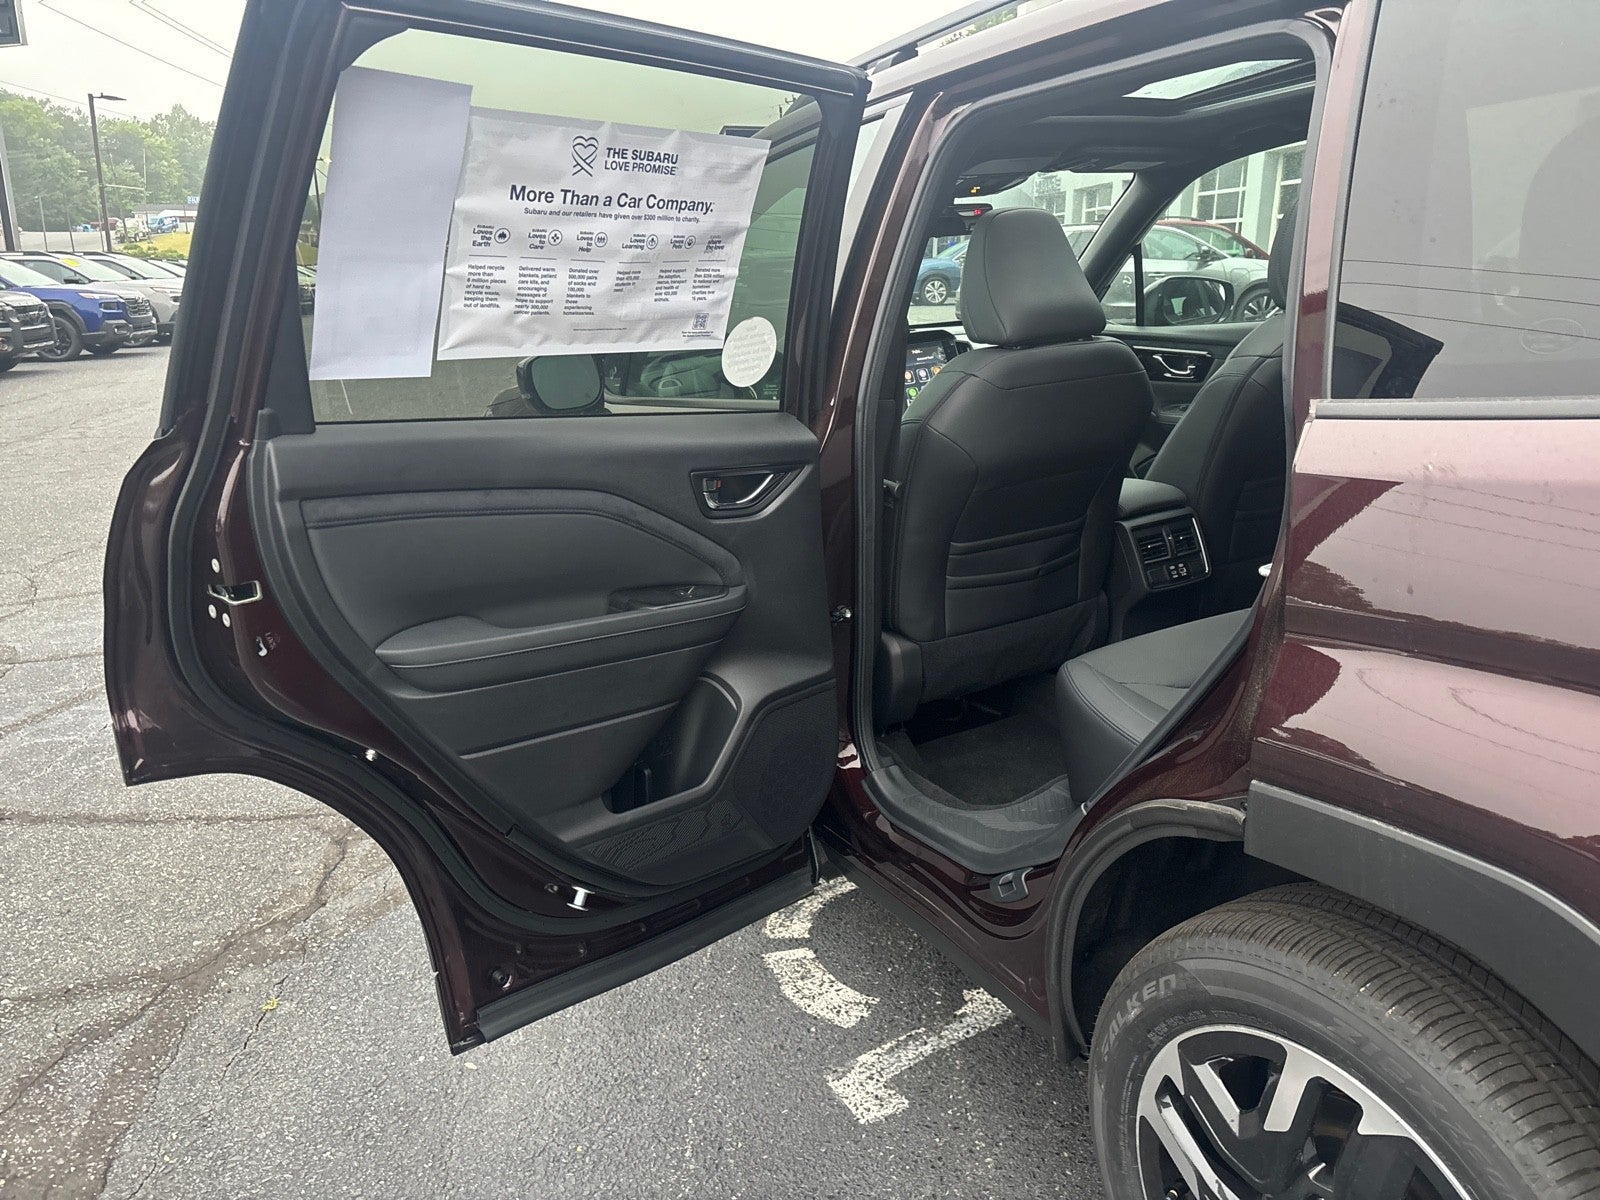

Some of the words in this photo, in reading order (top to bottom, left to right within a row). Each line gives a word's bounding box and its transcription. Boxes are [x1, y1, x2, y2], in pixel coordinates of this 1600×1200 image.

[605, 160, 630, 171] LOVE
[632, 163, 676, 175] PROMISE
[606, 148, 628, 159] THE
[631, 150, 678, 164] SUBARU
[510, 184, 554, 203] More
[560, 189, 599, 206] Than
[603, 195, 612, 207] a
[617, 192, 643, 209] Car
[646, 194, 714, 215] Company.
[1101, 973, 1177, 1062] FALKEN
